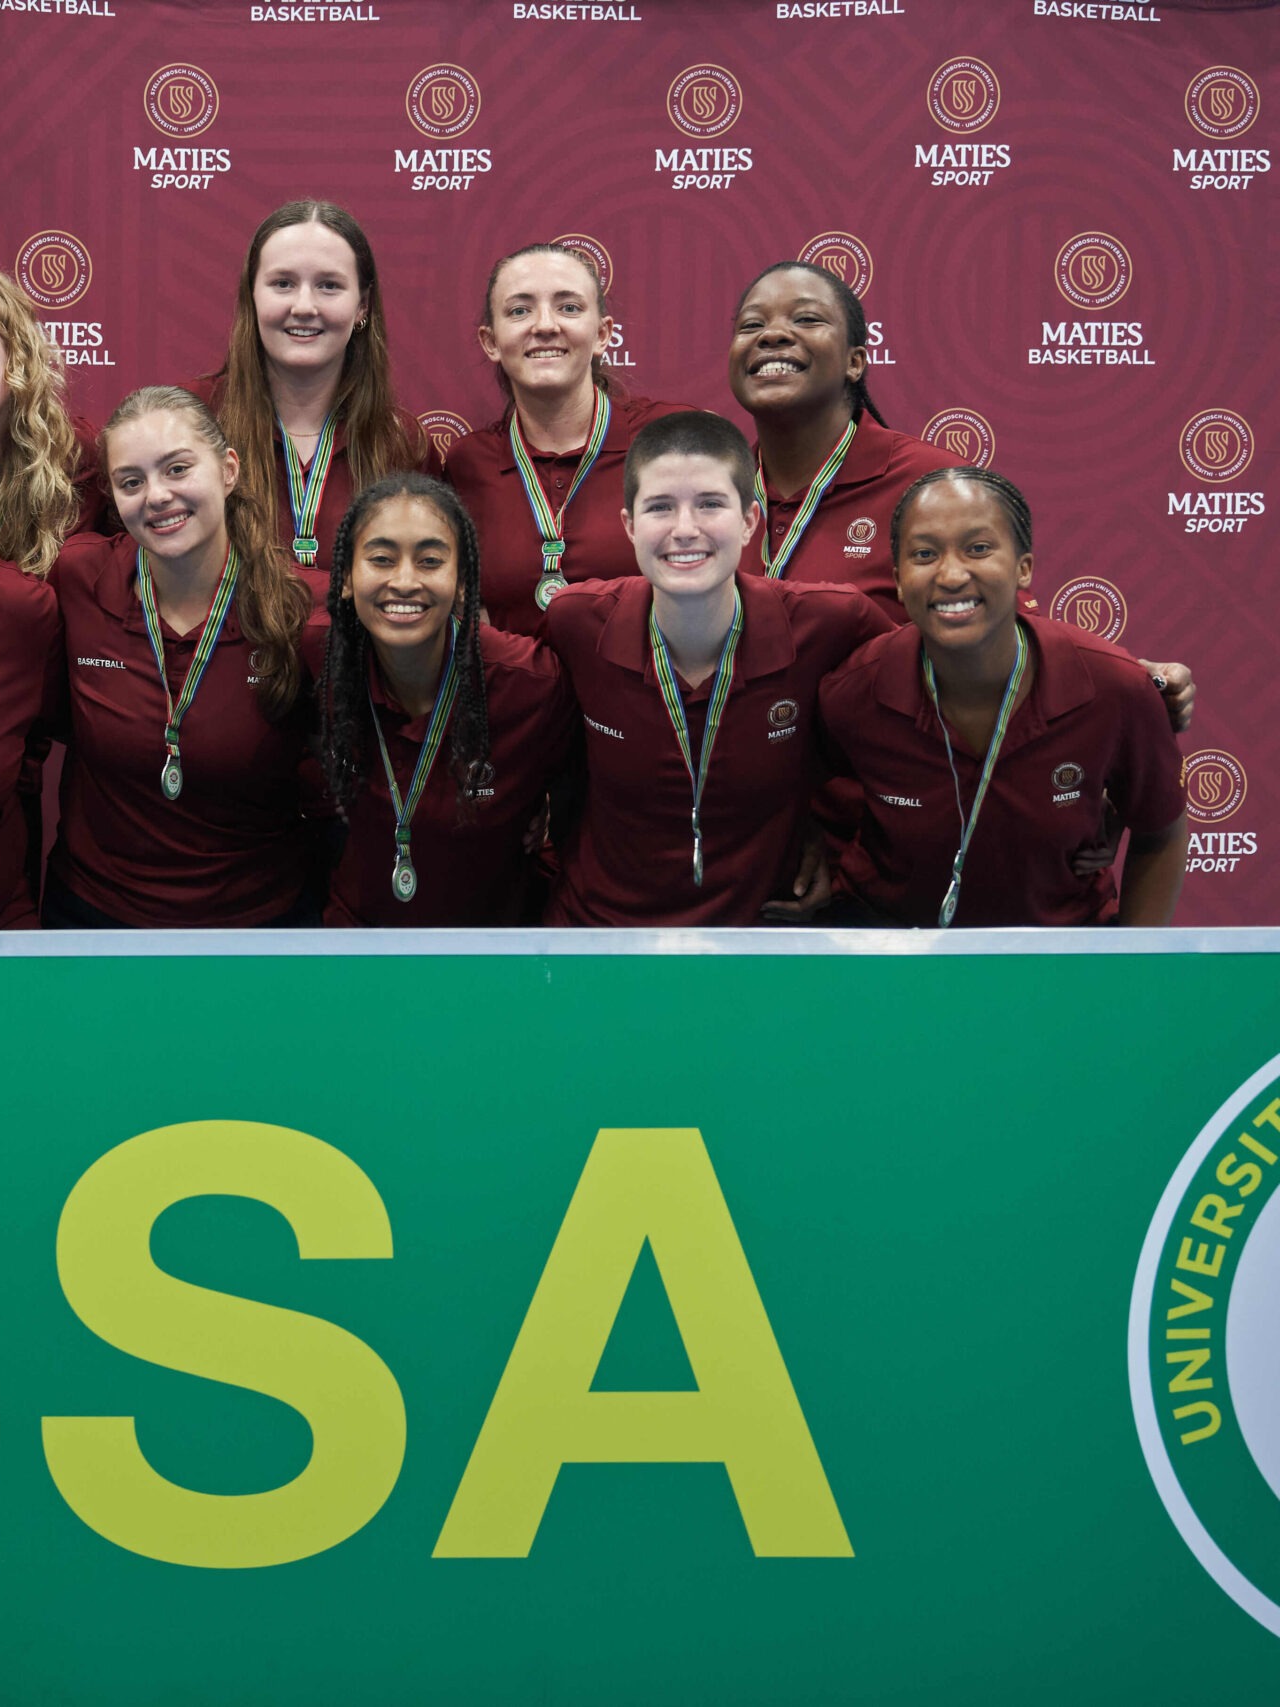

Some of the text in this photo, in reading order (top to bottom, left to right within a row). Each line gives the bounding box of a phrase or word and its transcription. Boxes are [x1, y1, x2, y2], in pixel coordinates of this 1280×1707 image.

[251, 6, 379, 21] BASKETBALL
[514, 4, 641, 20] BASKETBALL
[777, 0, 904, 18] BASKETBALL
[1034, 0, 1160, 21] BASKETBALL
[150, 69, 213, 97] STELLENBOSCH UNIVERSITY
[412, 69, 475, 97] STELLENBOSCH UNIVERSITY
[673, 70, 737, 97] STELLENBOSCH UNIVERSITY
[933, 62, 994, 91] STELLENBOSCH UNIVERSITY
[1190, 72, 1254, 99] STELLENBOSCH UNIVERSITY
[134, 147, 231, 171] MATIES
[395, 149, 491, 172] MATIES
[655, 148, 752, 171] MATIES
[915, 144, 1010, 167] MATIES
[1173, 149, 1270, 172] MATIES
[151, 174, 213, 189] SPORT
[412, 176, 474, 190] SPORT
[672, 174, 735, 189] SPORT
[932, 171, 993, 185] SPORT
[1190, 175, 1253, 189] SPORT
[22, 237, 86, 266] STELLENBOSCH UNIVERSITY
[581, 242, 606, 269] UNIVERSITY
[842, 239, 866, 267] UNIVERSITY
[1061, 238, 1126, 267] STELLENBOSCH UNIVERSITY
[45, 322, 103, 347] TIES
[1042, 322, 1142, 346] MATIES
[1029, 349, 1155, 364] BASKETBALL
[964, 415, 989, 442] UNIVERSITY
[1185, 414, 1248, 442] STELLENBOSCH UNIVERSITY
[1168, 493, 1265, 514] MATIES
[1185, 518, 1247, 532] SPORT
[844, 546, 872, 554] MATIES
[1096, 584, 1120, 611] UNIVERSITY
[77, 658, 126, 670] BASKETBALL
[768, 726, 796, 740] MATIES
[1216, 756, 1240, 782] UNIVERSITY
[1052, 790, 1080, 802] MATIES
[1187, 832, 1258, 855] ATIES
